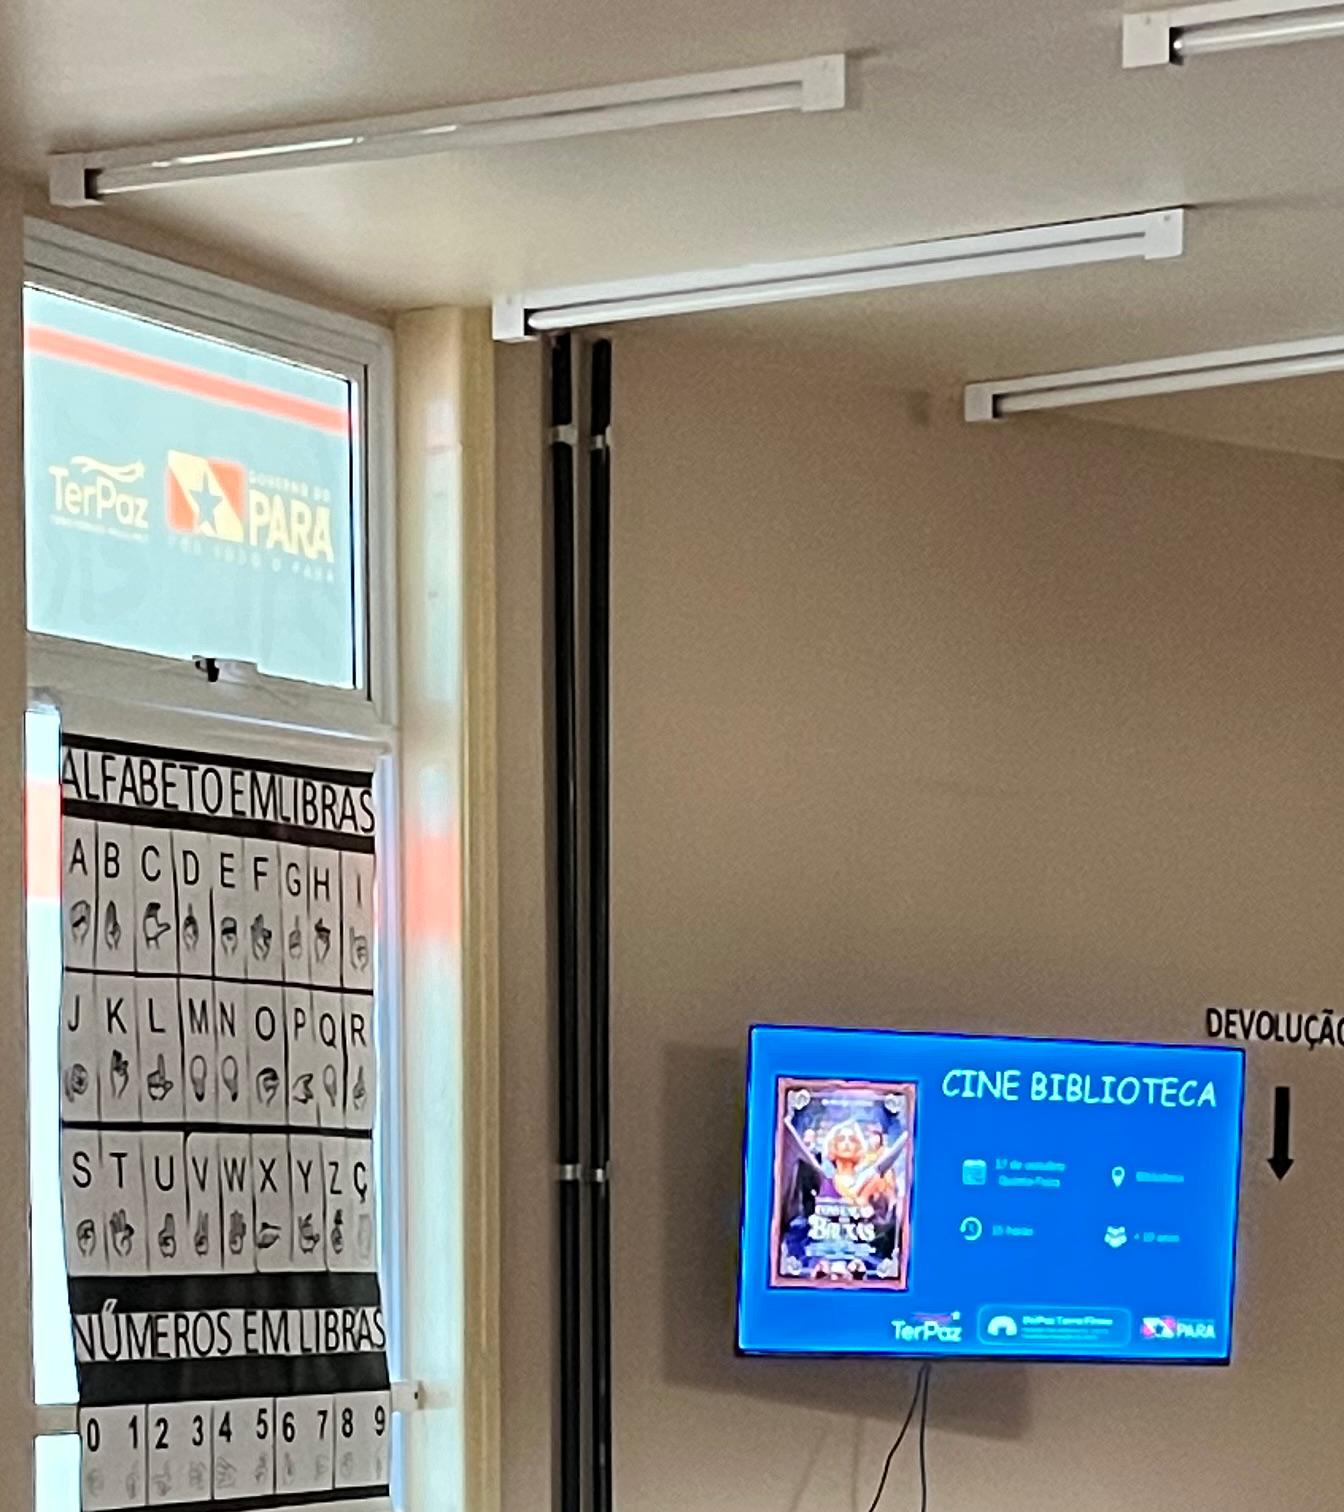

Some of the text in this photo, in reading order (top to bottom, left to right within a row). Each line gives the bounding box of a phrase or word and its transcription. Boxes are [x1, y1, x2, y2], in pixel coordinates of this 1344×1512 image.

[48, 465, 149, 528] TerPaz
[62, 748, 376, 834] ALFABETO EM LIBRAS
[69, 838, 88, 876] A
[104, 842, 120, 878] B
[141, 845, 161, 881] C
[183, 850, 199, 885] D
[220, 853, 235, 888] E
[255, 857, 269, 891] F
[286, 862, 301, 897] G
[314, 866, 330, 901] H
[67, 995, 367, 1048] J K L M N O P Q R
[942, 1069, 1217, 1107] CINE BIBLIOTECA
[72, 1151, 368, 1199] S T U V W X Y Z Ç
[73, 1298, 386, 1361] NÚMEROS EM LIBRAS
[891, 1320, 962, 1342] TerPaz
[86, 1405, 386, 1452] 0 1 2 3 4 5 6 7 8 9
